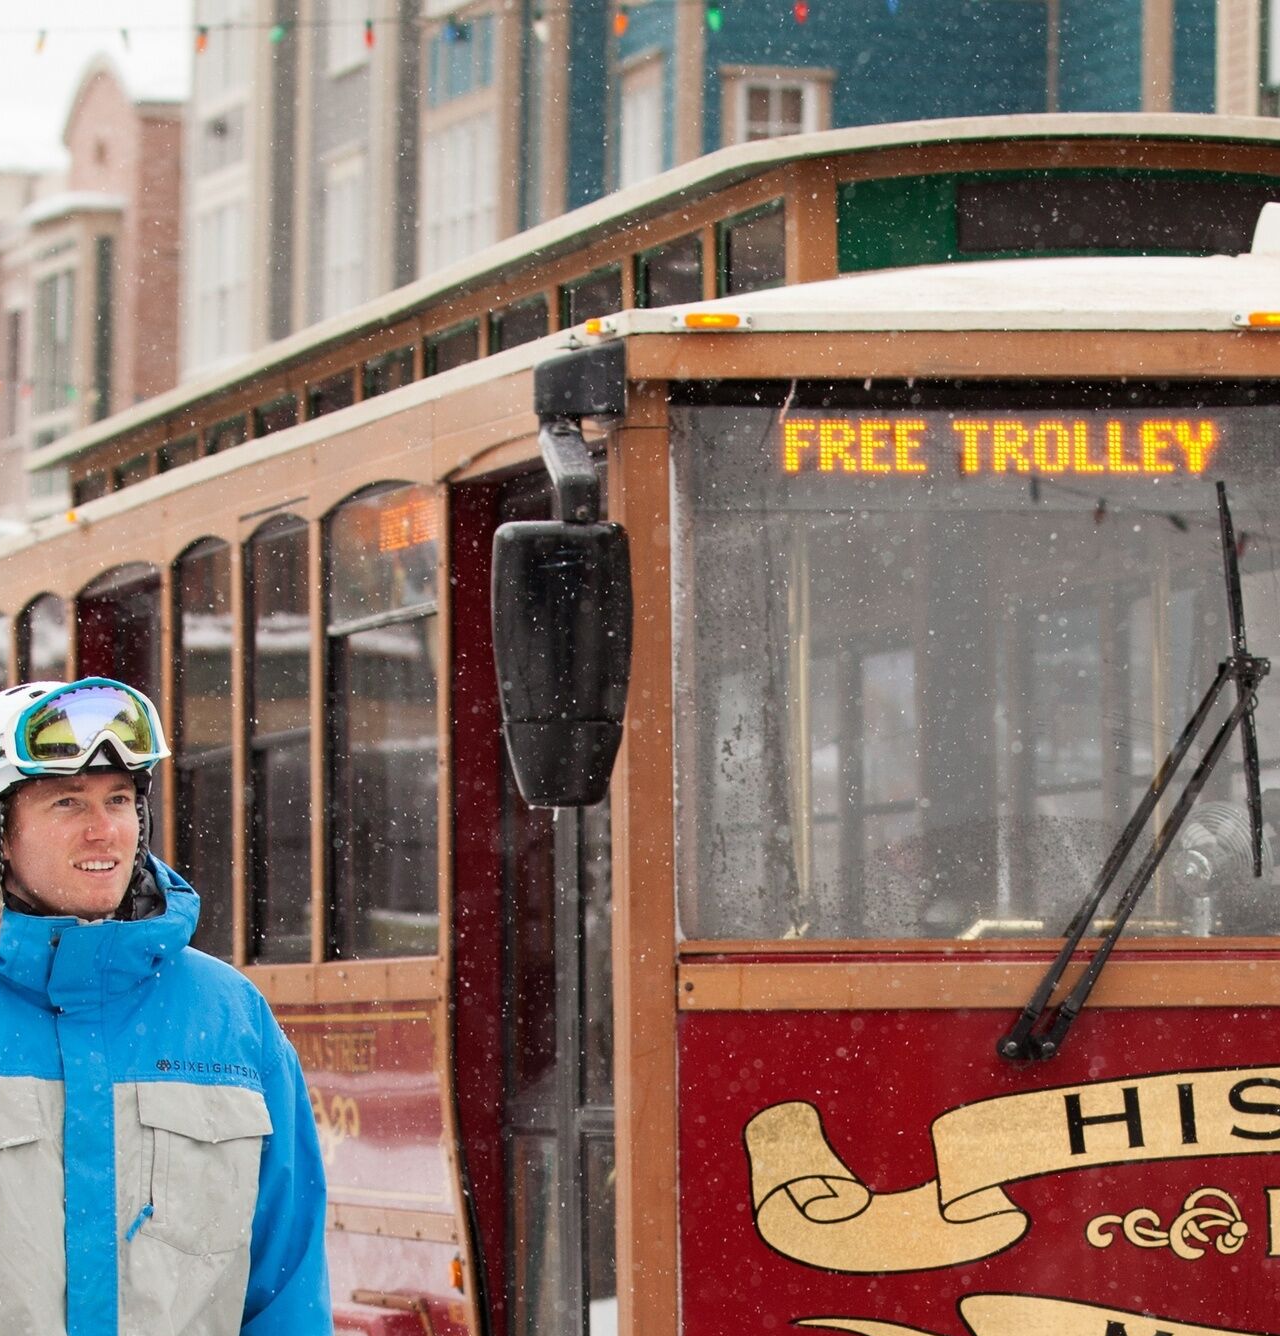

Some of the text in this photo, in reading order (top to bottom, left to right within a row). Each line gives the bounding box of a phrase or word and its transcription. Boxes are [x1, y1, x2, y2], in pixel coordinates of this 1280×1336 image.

[781, 419, 1215, 474] FREE TROLLEY
[173, 1060, 260, 1081] SIXEIGHTSIX
